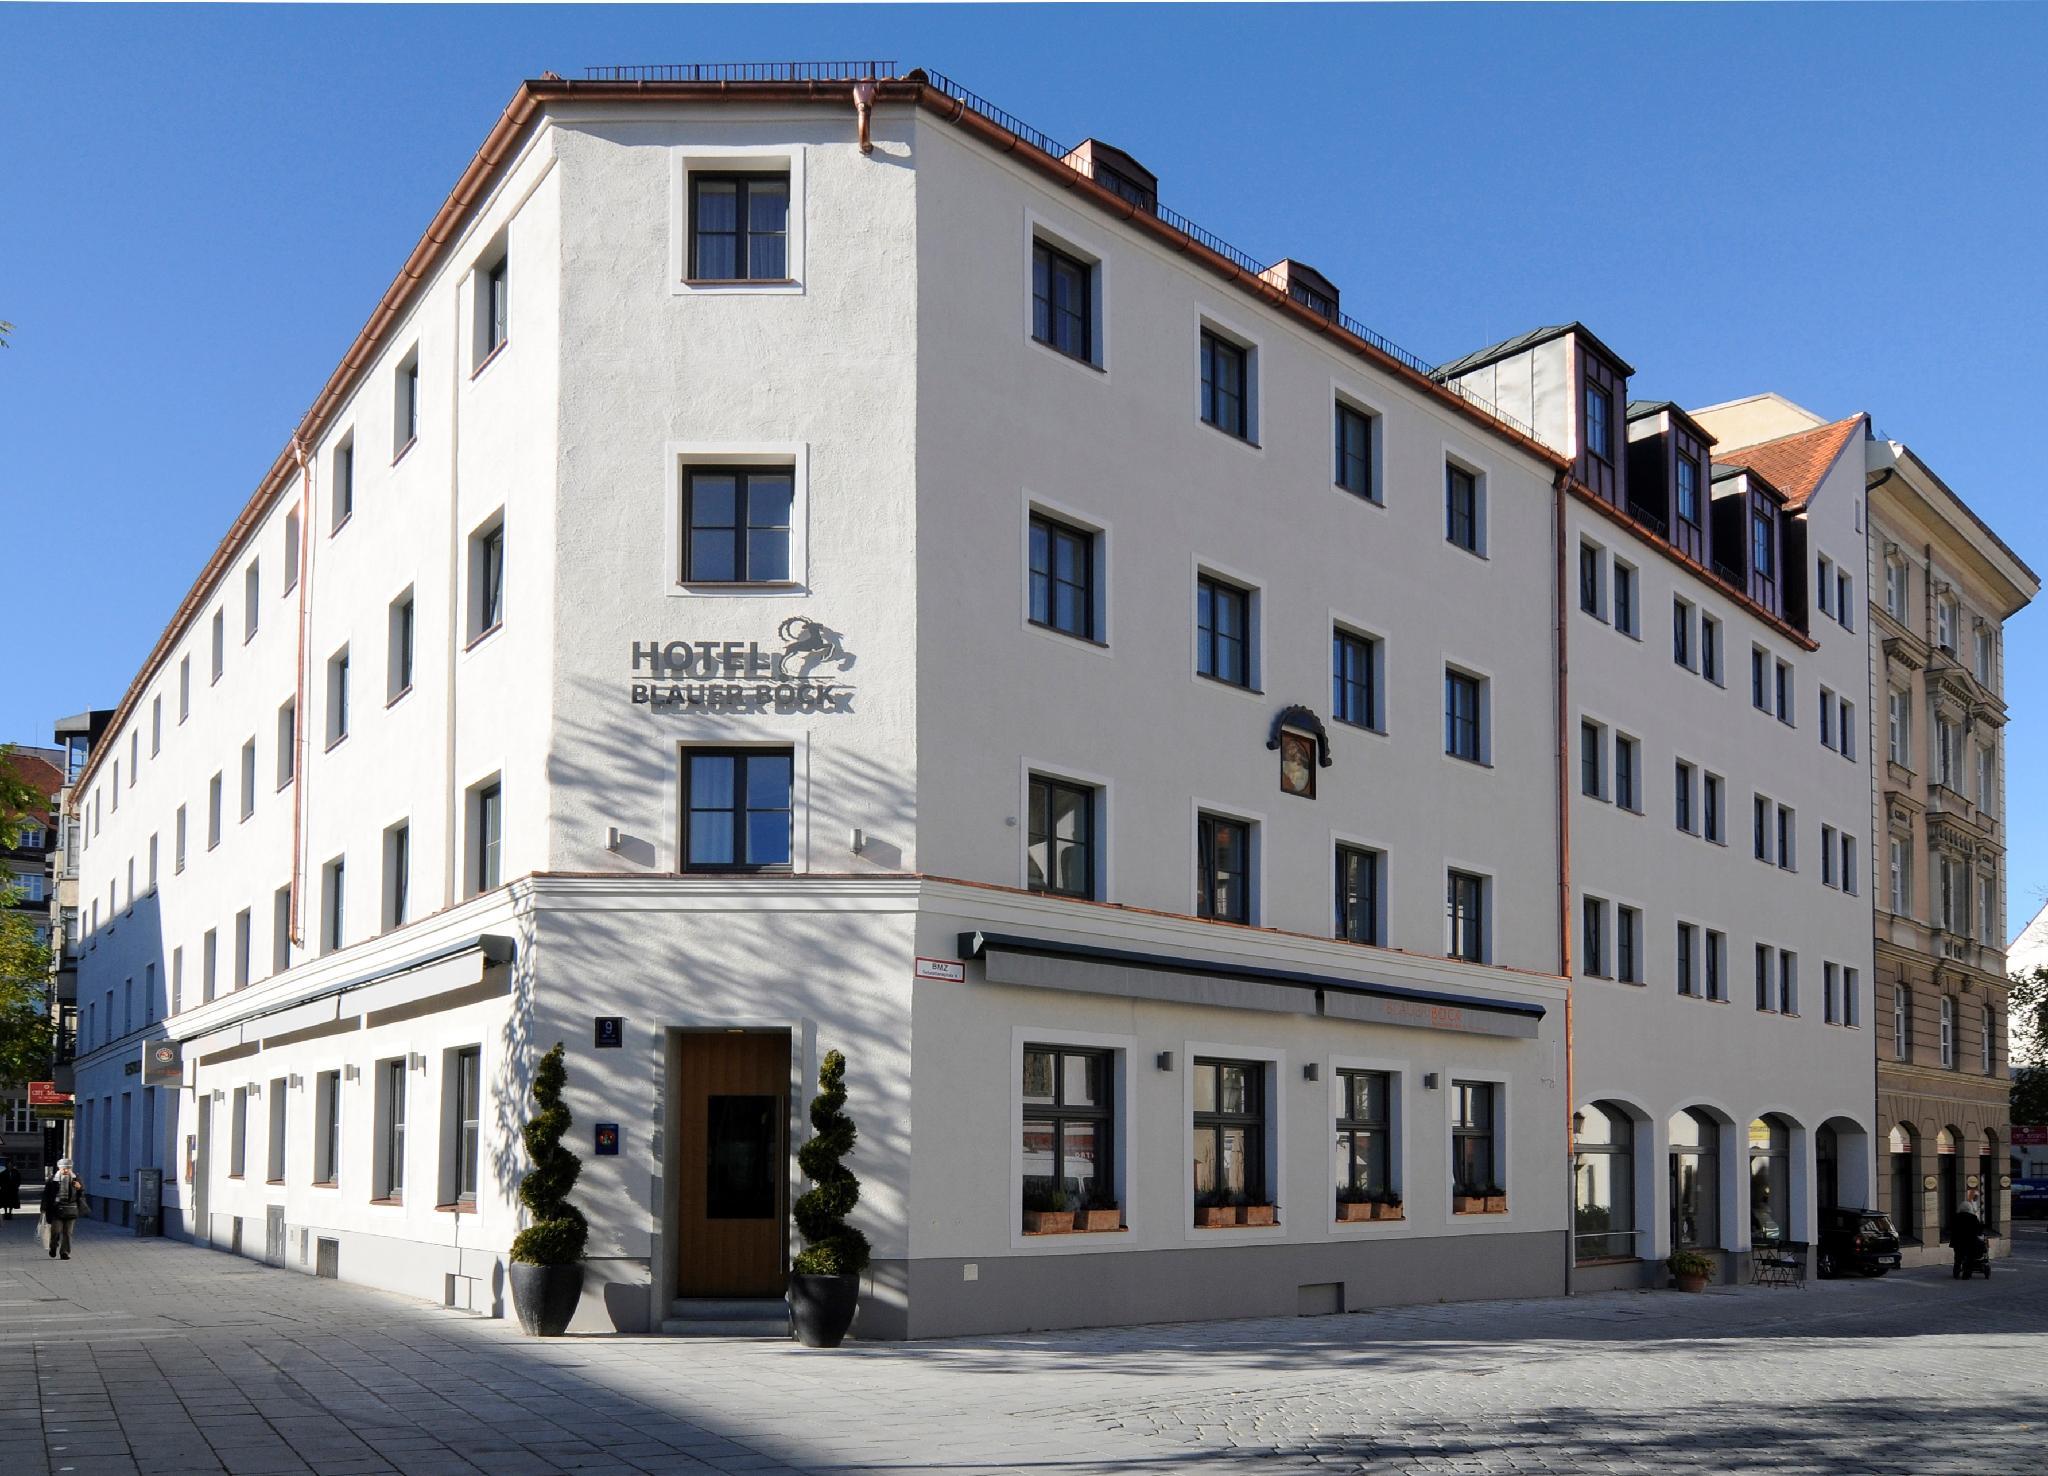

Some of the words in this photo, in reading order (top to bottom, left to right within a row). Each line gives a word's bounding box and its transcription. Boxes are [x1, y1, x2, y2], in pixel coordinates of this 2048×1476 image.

[632, 641, 770, 671] HOTEL
[632, 684, 746, 705] BLAUER
[757, 684, 835, 705] BOCK
[932, 963, 949, 972] BMZ
[605, 1021, 613, 1034] 9
